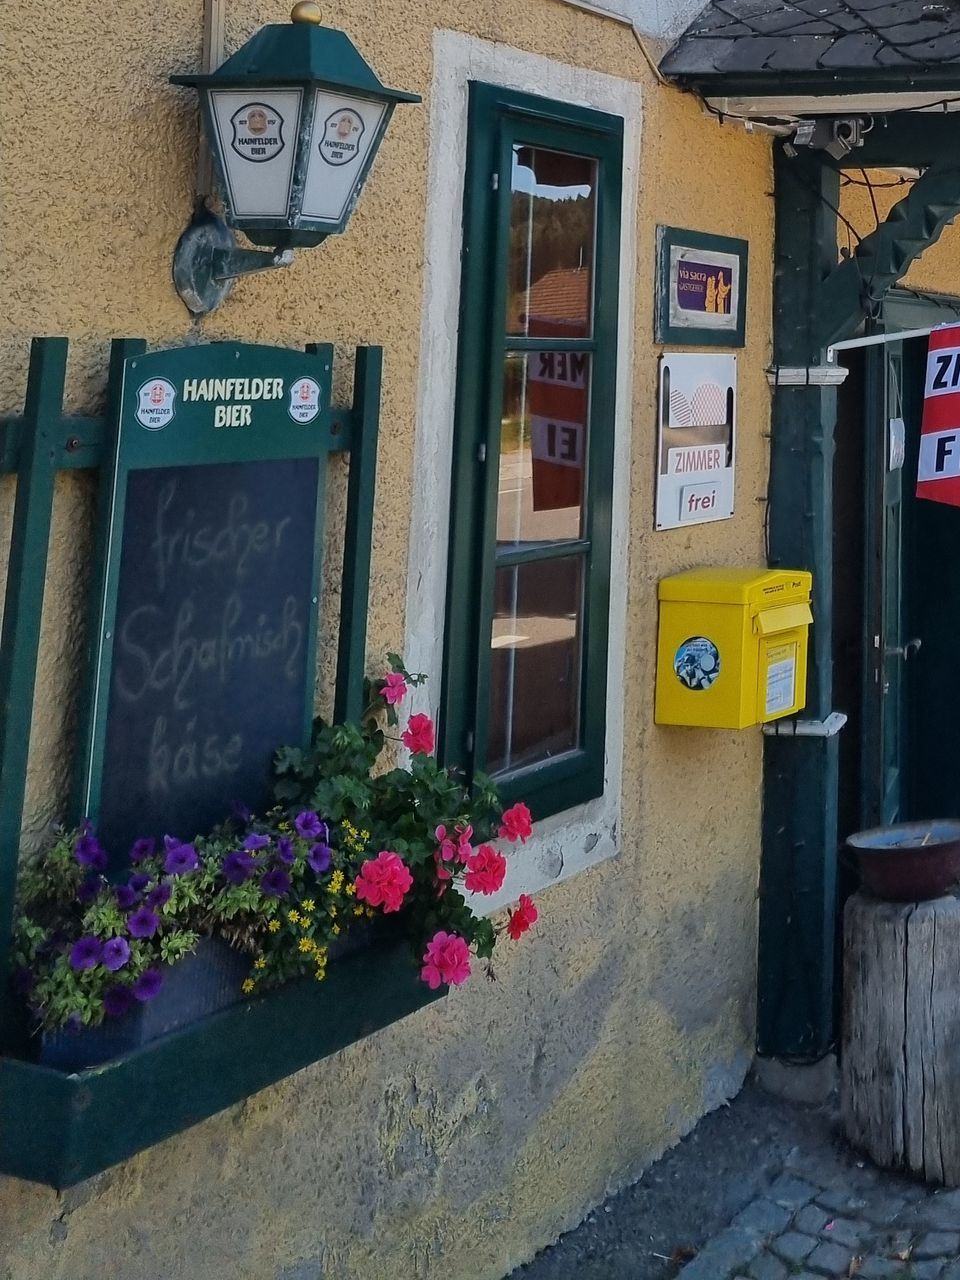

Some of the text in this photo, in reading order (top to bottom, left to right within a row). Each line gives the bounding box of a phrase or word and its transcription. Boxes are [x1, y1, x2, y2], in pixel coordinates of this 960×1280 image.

[183, 378, 284, 402] HAINFELDER
[214, 405, 252, 428] BIER
[674, 449, 721, 473] ZIMMER
[687, 490, 717, 512] frei
